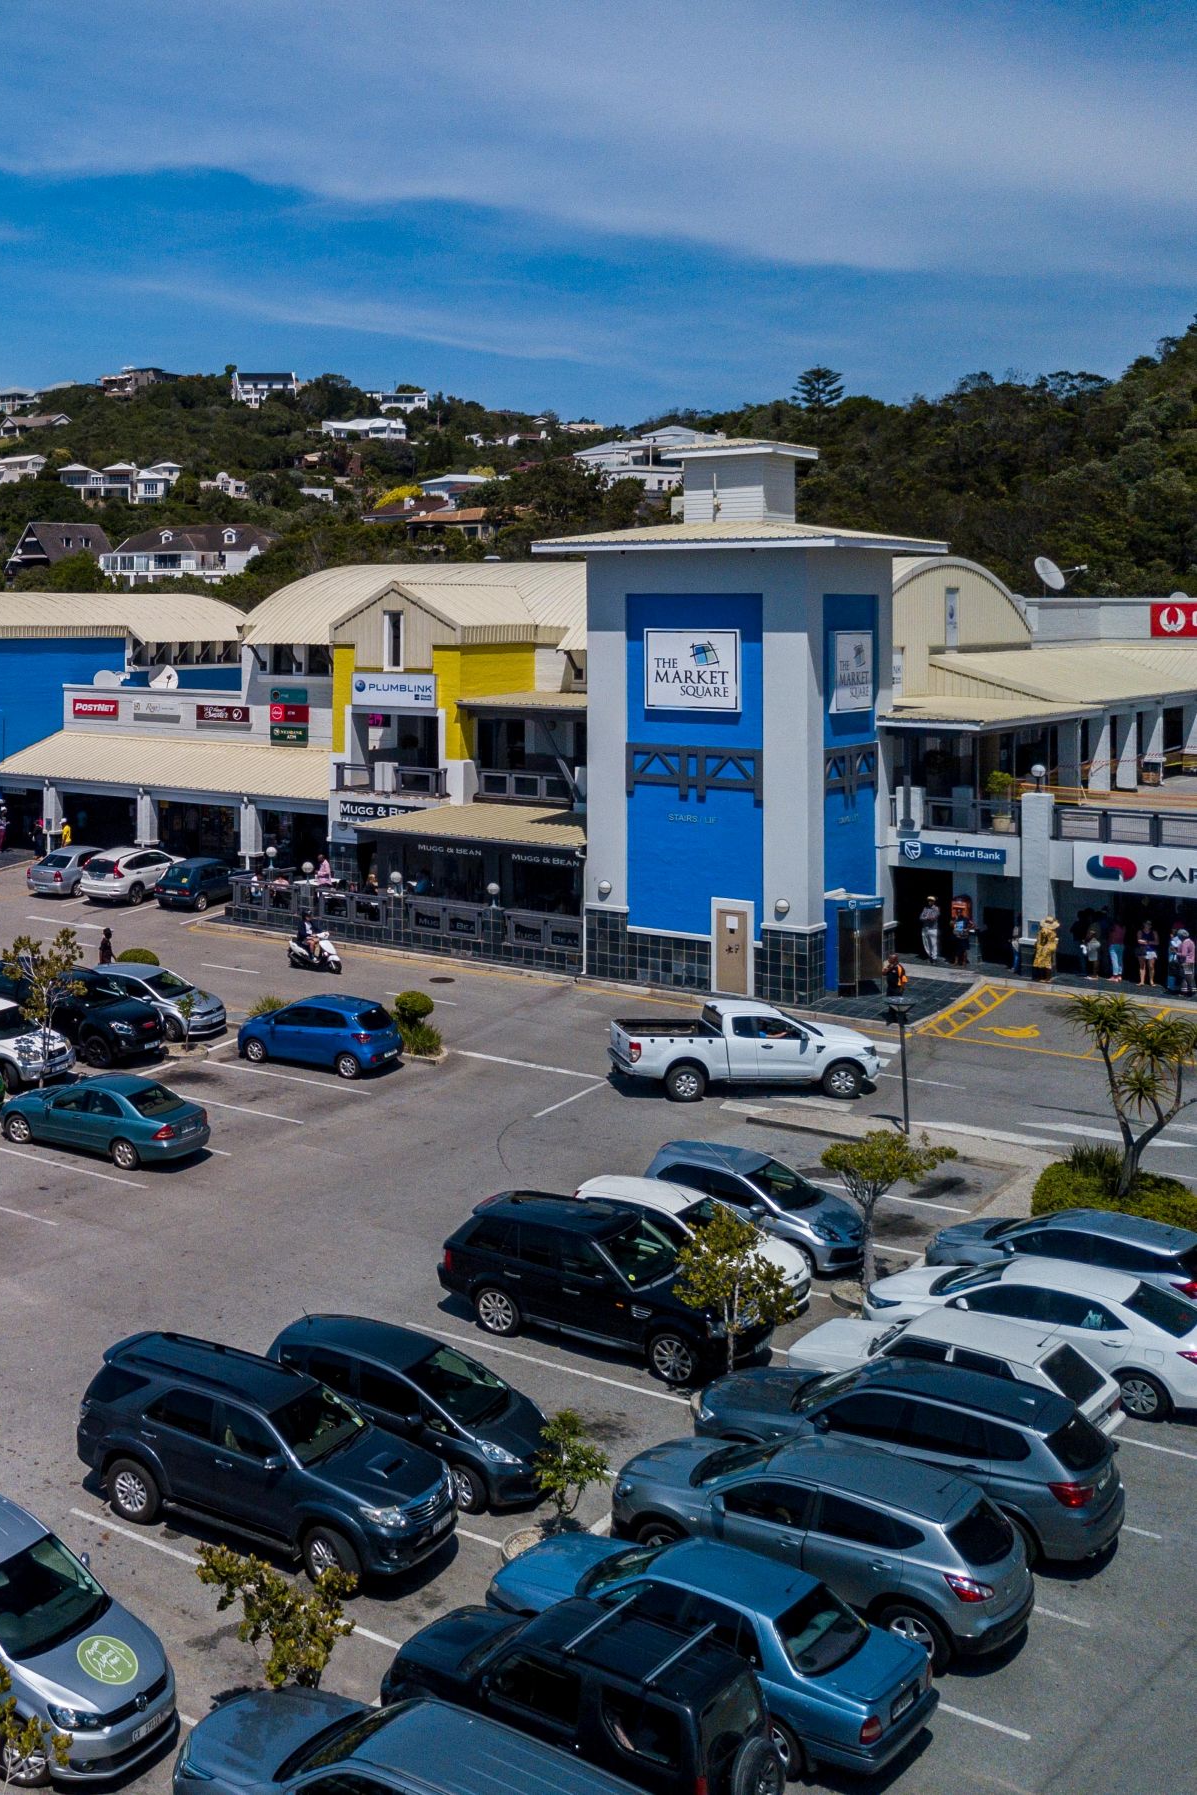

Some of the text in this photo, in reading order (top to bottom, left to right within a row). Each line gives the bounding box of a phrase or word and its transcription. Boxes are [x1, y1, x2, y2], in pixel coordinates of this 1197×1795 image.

[654, 657, 678, 668] THE
[839, 660, 850, 671] THE
[654, 669, 729, 685] MARKET
[839, 671, 870, 686] MARKET
[368, 683, 432, 693] PLUMBLINK
[680, 685, 729, 698] SQUARE
[377, 806, 386, 816] &
[456, 848, 482, 856] BEAN
[934, 846, 1001, 860] Standard Bank
[553, 857, 580, 867] BEAN
